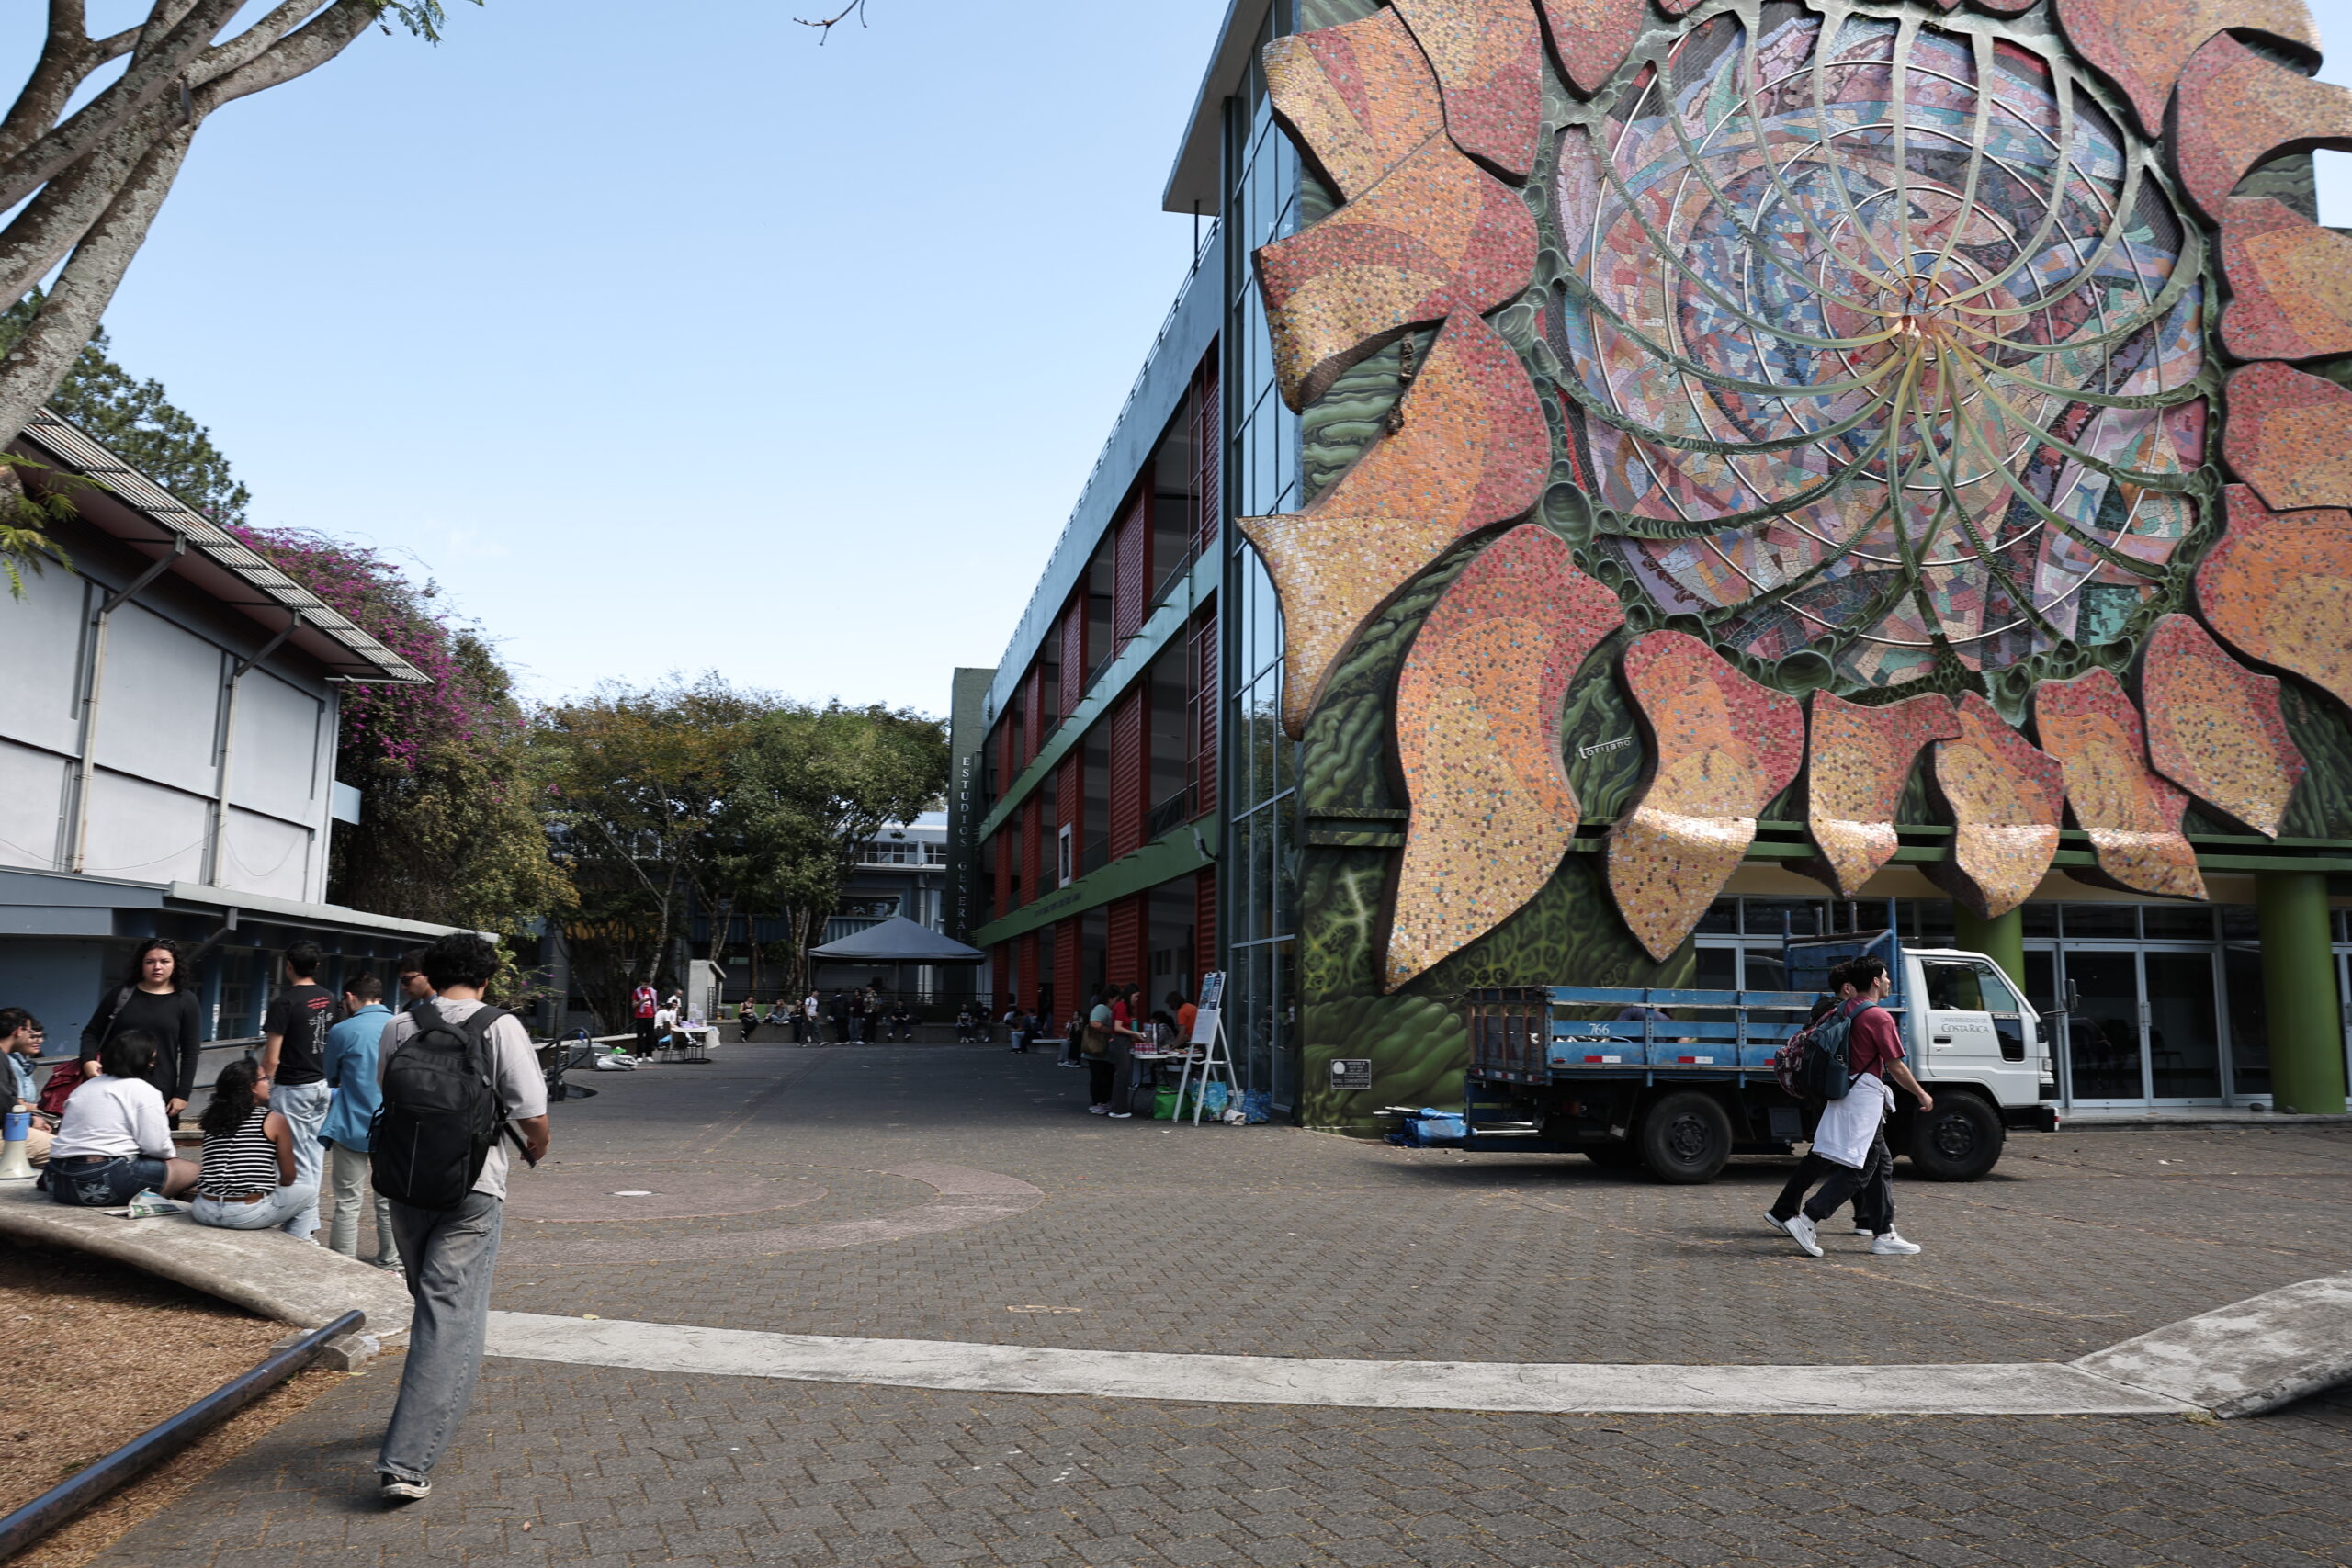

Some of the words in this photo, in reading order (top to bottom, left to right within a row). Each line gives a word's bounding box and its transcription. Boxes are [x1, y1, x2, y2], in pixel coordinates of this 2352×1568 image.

[1579, 737, 1632, 759] torijano
[958, 757, 970, 847] ESTUDIOS
[1589, 1023, 1610, 1035] 766
[1940, 1023, 1969, 1033] COSTA
[1969, 1024, 1990, 1033] RICA
